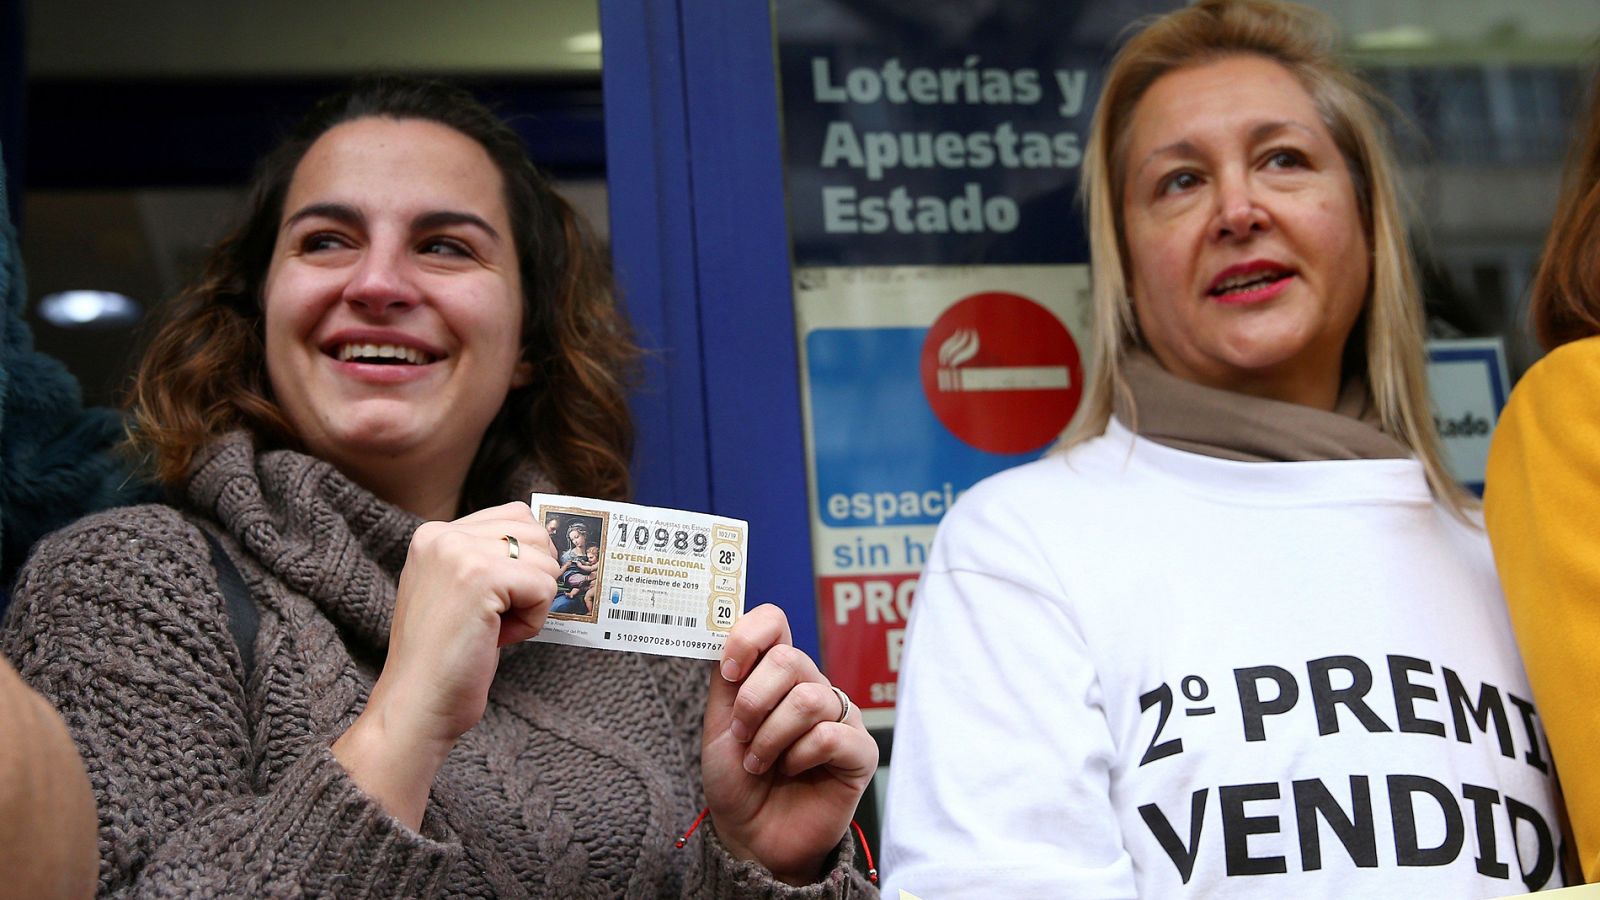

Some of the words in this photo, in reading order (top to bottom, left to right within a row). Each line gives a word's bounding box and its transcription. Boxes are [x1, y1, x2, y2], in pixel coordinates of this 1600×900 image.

[811, 55, 1042, 104] Loterías
[1054, 69, 1088, 117] y
[820, 121, 1082, 181] Apuestas
[821, 183, 1020, 234] Estado
[827, 483, 966, 525] espaci
[618, 523, 708, 553] 10989
[833, 537, 889, 569] sin
[904, 535, 932, 567] h
[611, 552, 653, 564] LOTERÍA
[656, 558, 705, 570] NACIONAL
[627, 565, 640, 573] DE
[643, 566, 688, 578] NAVIDAD
[624, 575, 634, 583] de
[635, 577, 670, 587] diciembre
[672, 580, 681, 589] de
[682, 582, 699, 590] 2019
[717, 606, 731, 619] 20
[1139, 675, 1216, 768] 2º
[1233, 654, 1548, 776] PREMI
[1138, 774, 1566, 893] VENDID
